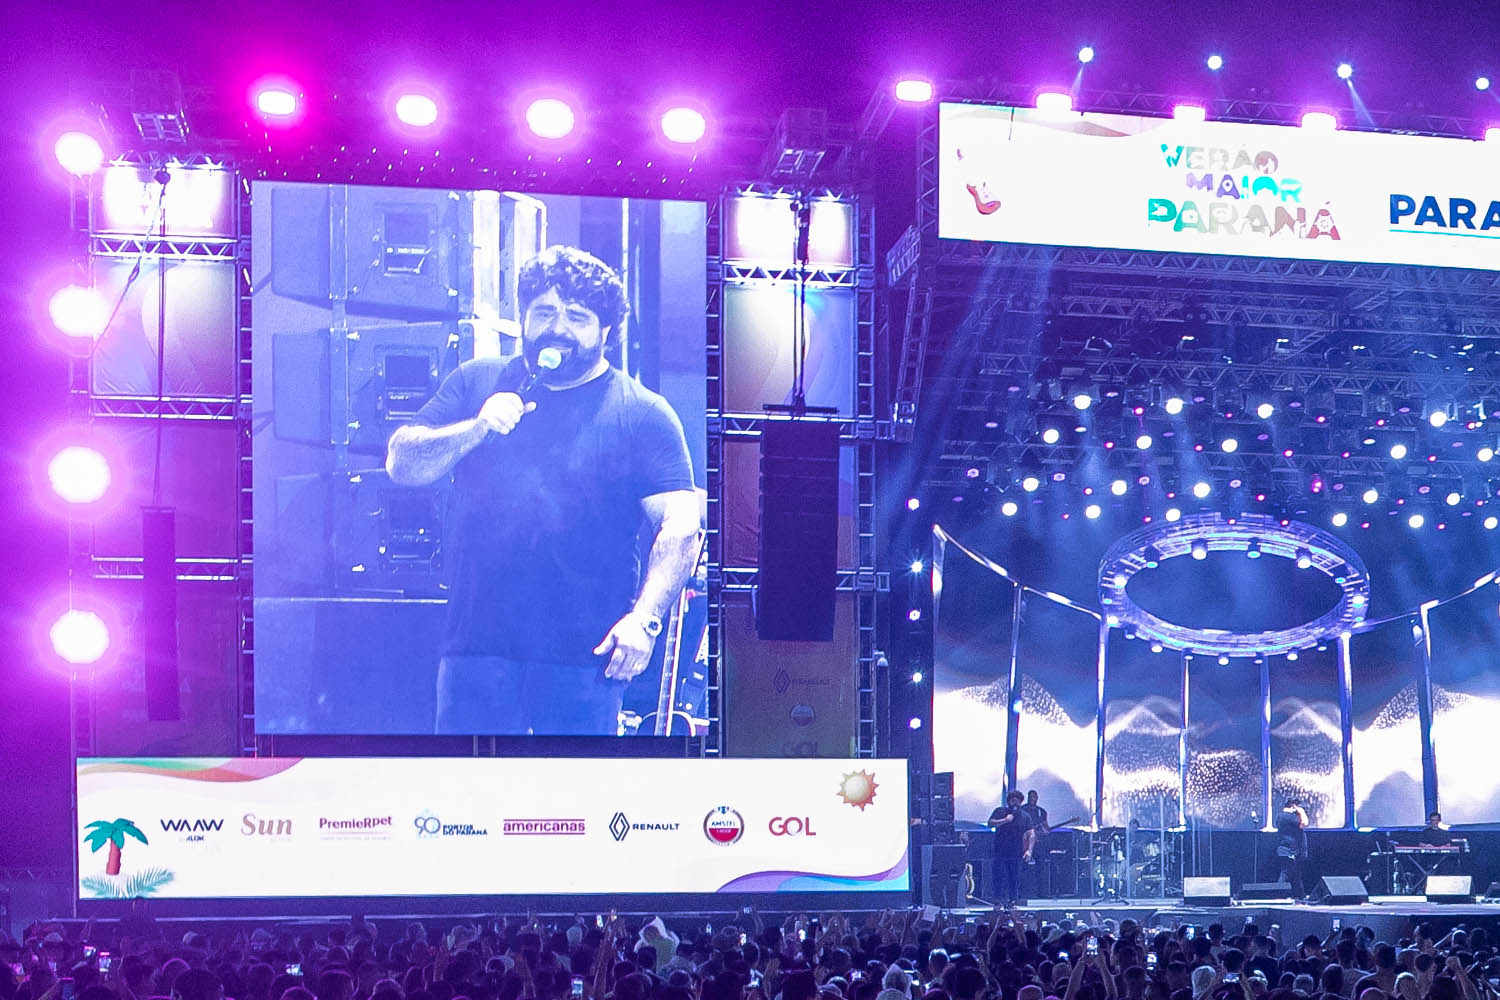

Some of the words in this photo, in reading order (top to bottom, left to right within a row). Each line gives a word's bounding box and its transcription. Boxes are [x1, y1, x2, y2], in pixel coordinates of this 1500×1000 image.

[1186, 173, 1303, 203] MAIOR
[1148, 197, 1342, 241] PARANÁ
[160, 818, 225, 832] WAAW
[240, 813, 293, 836] Sun
[503, 821, 585, 833] americanas
[631, 822, 681, 832] RENAULT
[769, 816, 817, 837] GOL
